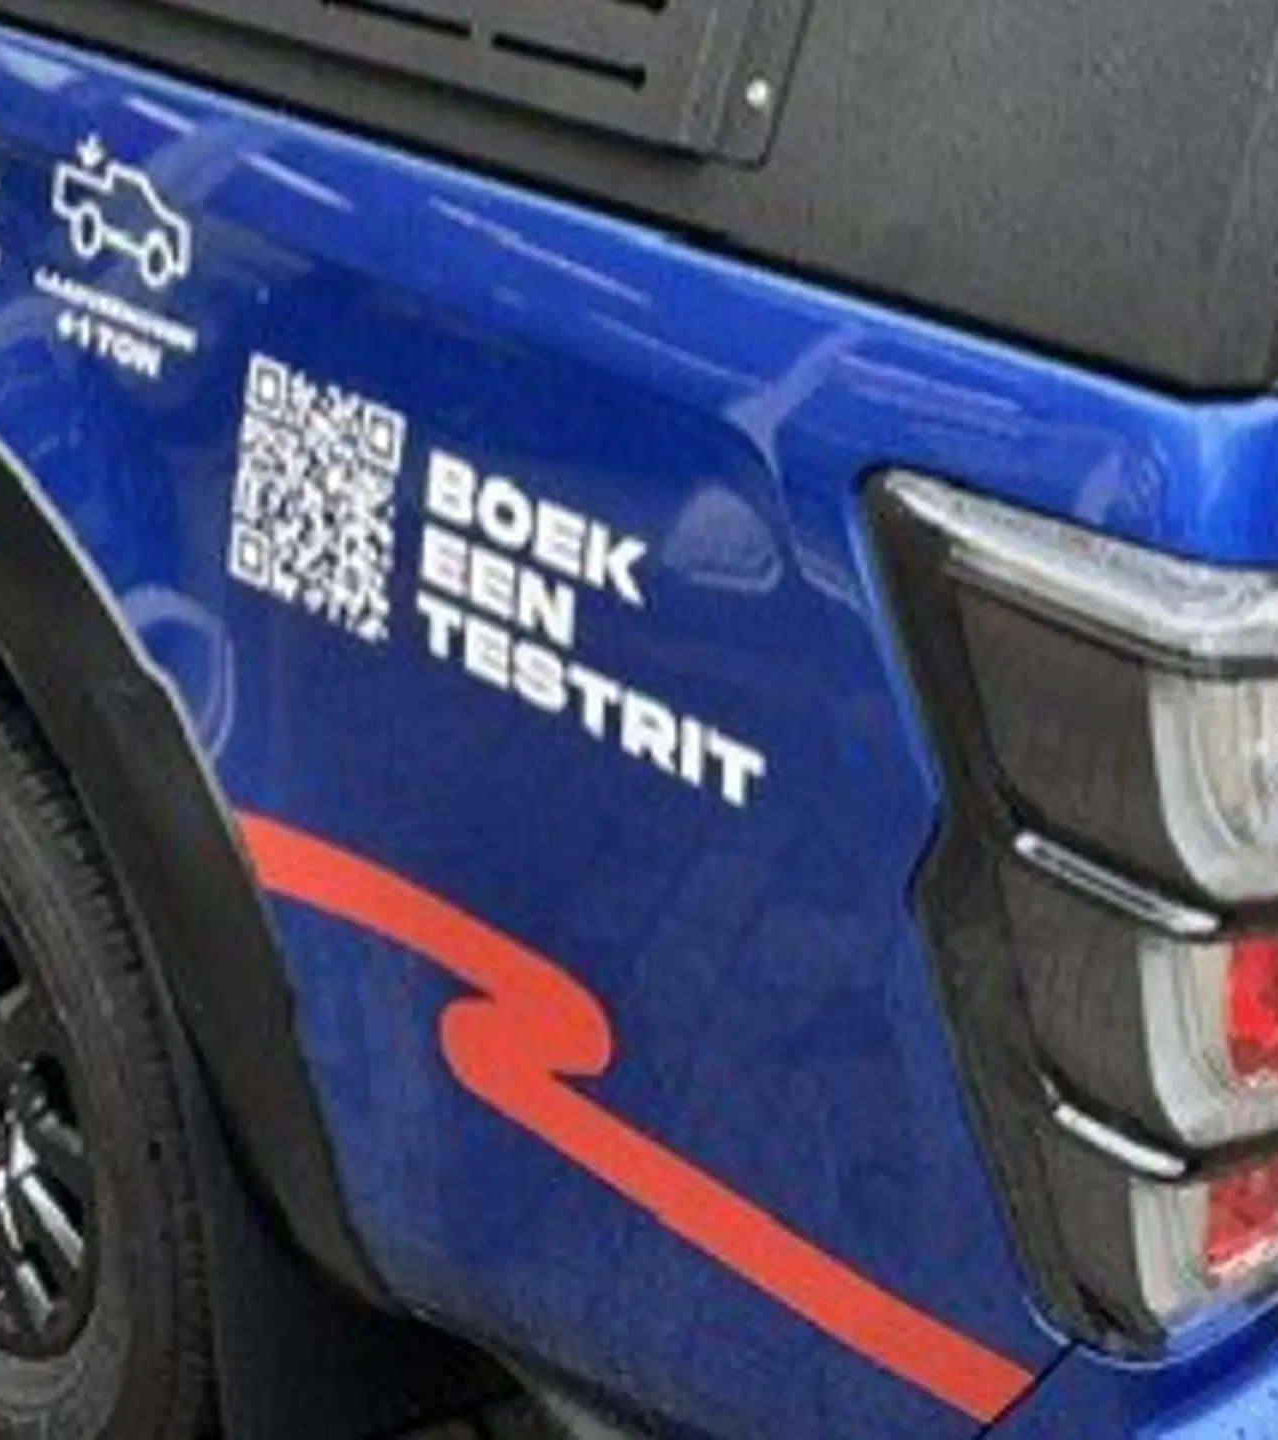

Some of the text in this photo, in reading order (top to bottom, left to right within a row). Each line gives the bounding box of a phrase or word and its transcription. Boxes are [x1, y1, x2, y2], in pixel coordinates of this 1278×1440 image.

[420, 522, 576, 651] EEN
[425, 448, 647, 608] BOEK
[416, 588, 766, 808] TESTRIT
